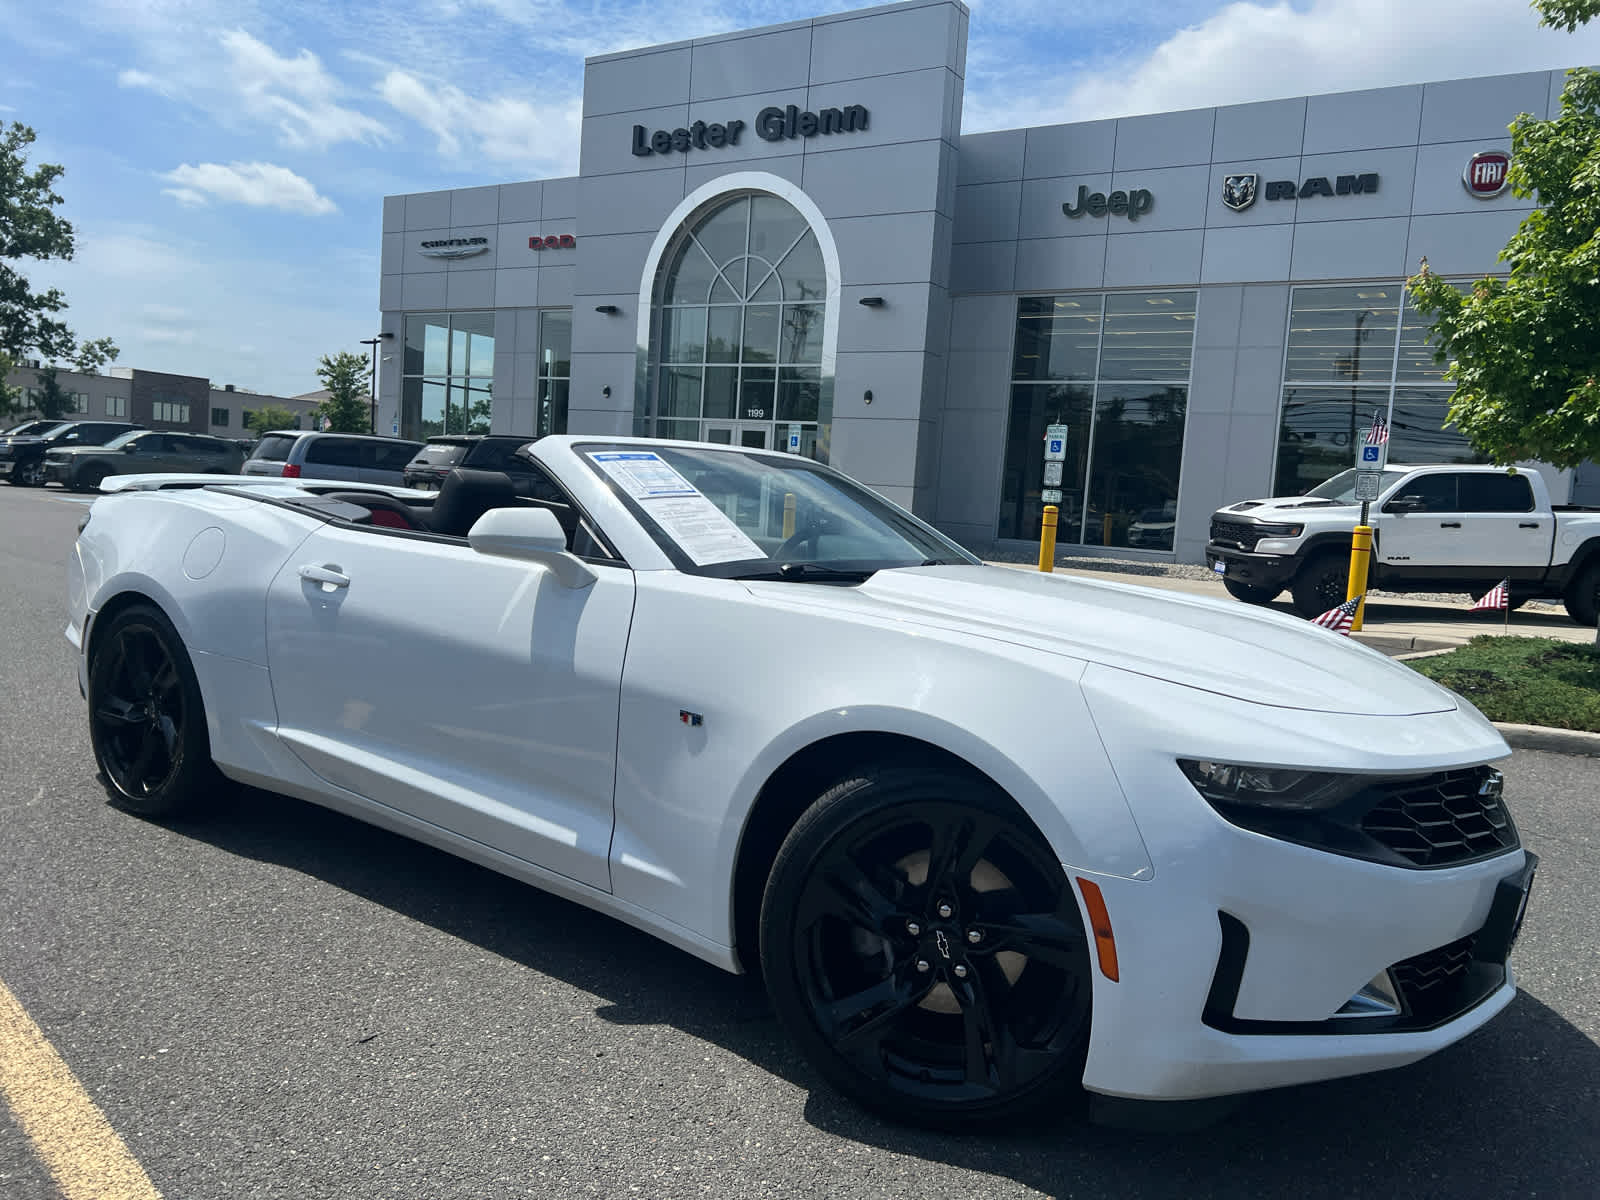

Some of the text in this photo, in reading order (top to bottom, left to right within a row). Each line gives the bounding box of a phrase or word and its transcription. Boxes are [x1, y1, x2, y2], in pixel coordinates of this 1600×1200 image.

[632, 104, 869, 157] Lester Glenn
[1474, 161, 1505, 184] FIAT
[1265, 173, 1380, 201] RAM
[1062, 184, 1154, 222] Jeep
[528, 234, 577, 249] DOD
[747, 408, 764, 418] 1199
